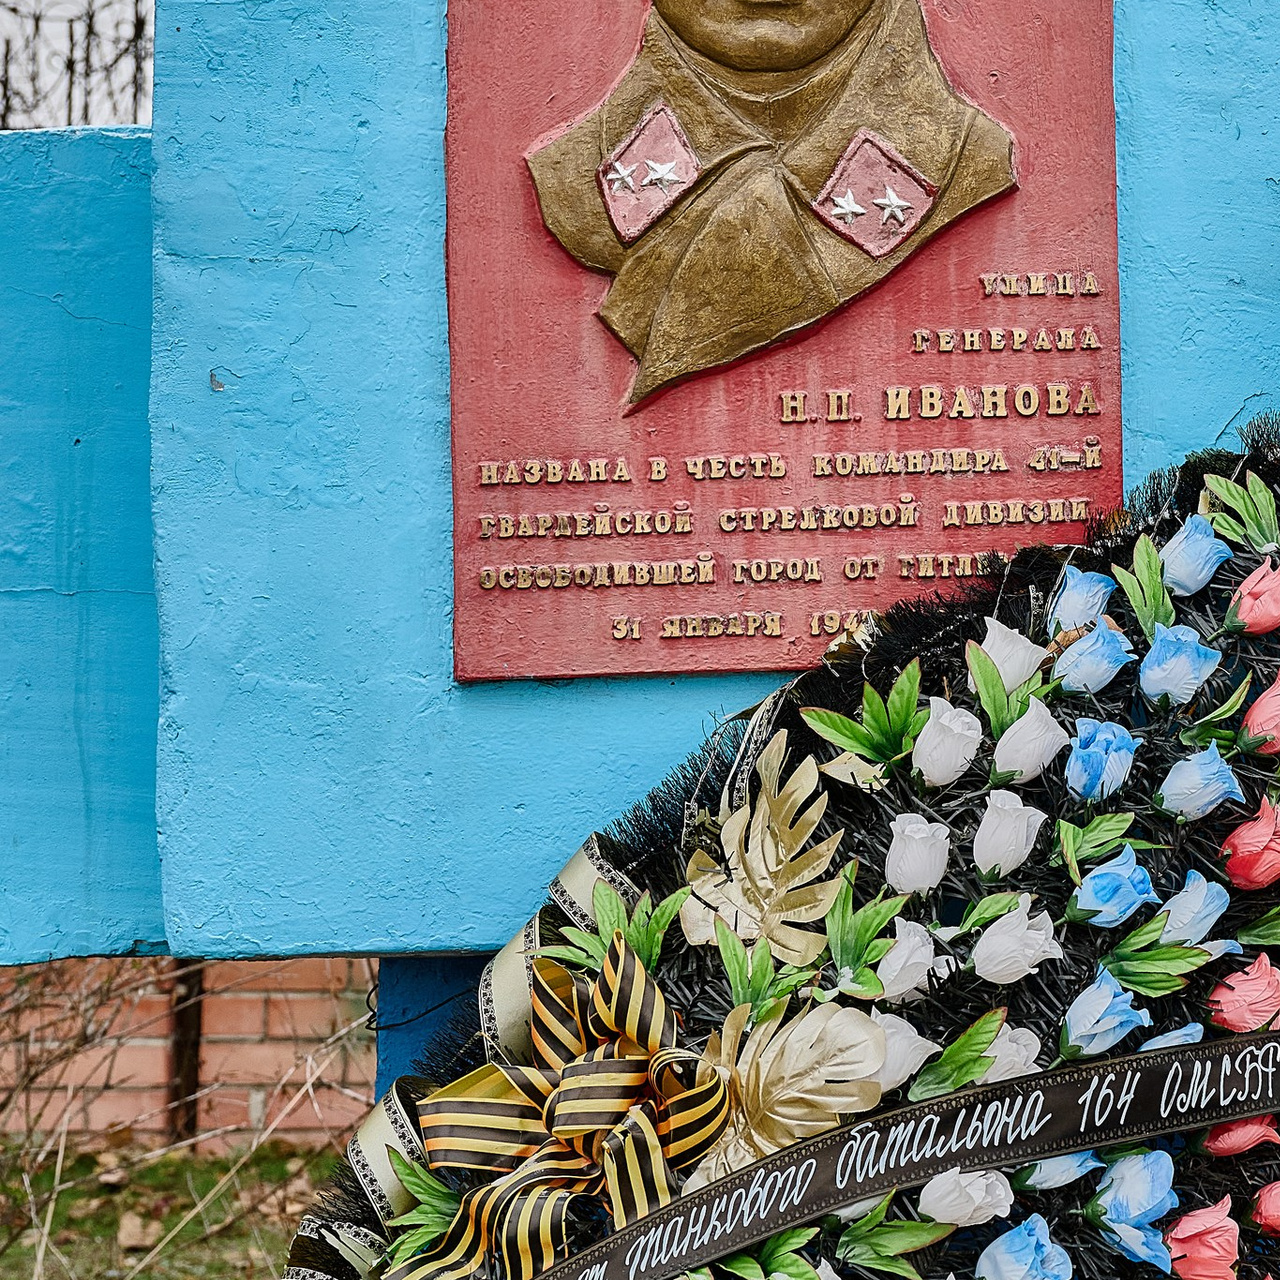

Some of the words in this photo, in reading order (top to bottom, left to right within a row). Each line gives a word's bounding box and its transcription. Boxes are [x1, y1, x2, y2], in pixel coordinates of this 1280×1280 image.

[981, 273, 1100, 297] УЛИЦА
[912, 328, 1101, 352] ГЕНЕРАЛА
[886, 384, 1100, 420] ИВАНОВА
[480, 460, 632, 485] НАЗВАНА
[650, 458, 668, 482] В
[686, 455, 787, 480] ЧЕСТЬ
[813, 450, 1009, 476] КОМАНДИРА
[480, 503, 693, 539] ГВАРДЕЙСКОЙ
[719, 496, 918, 531] СТРЕЛКОВОЙ
[943, 501, 1088, 527] ДИВИЗИИ
[479, 554, 716, 590] ОСВОБОДИВШЕЙ
[733, 561, 823, 583] ГОРОД
[845, 558, 877, 579] ОТ
[612, 618, 642, 640] 31
[662, 615, 783, 638] ЯНВАРЯ
[835, 1088, 1053, 1190] батальона
[1077, 1069, 1142, 1133] 164
